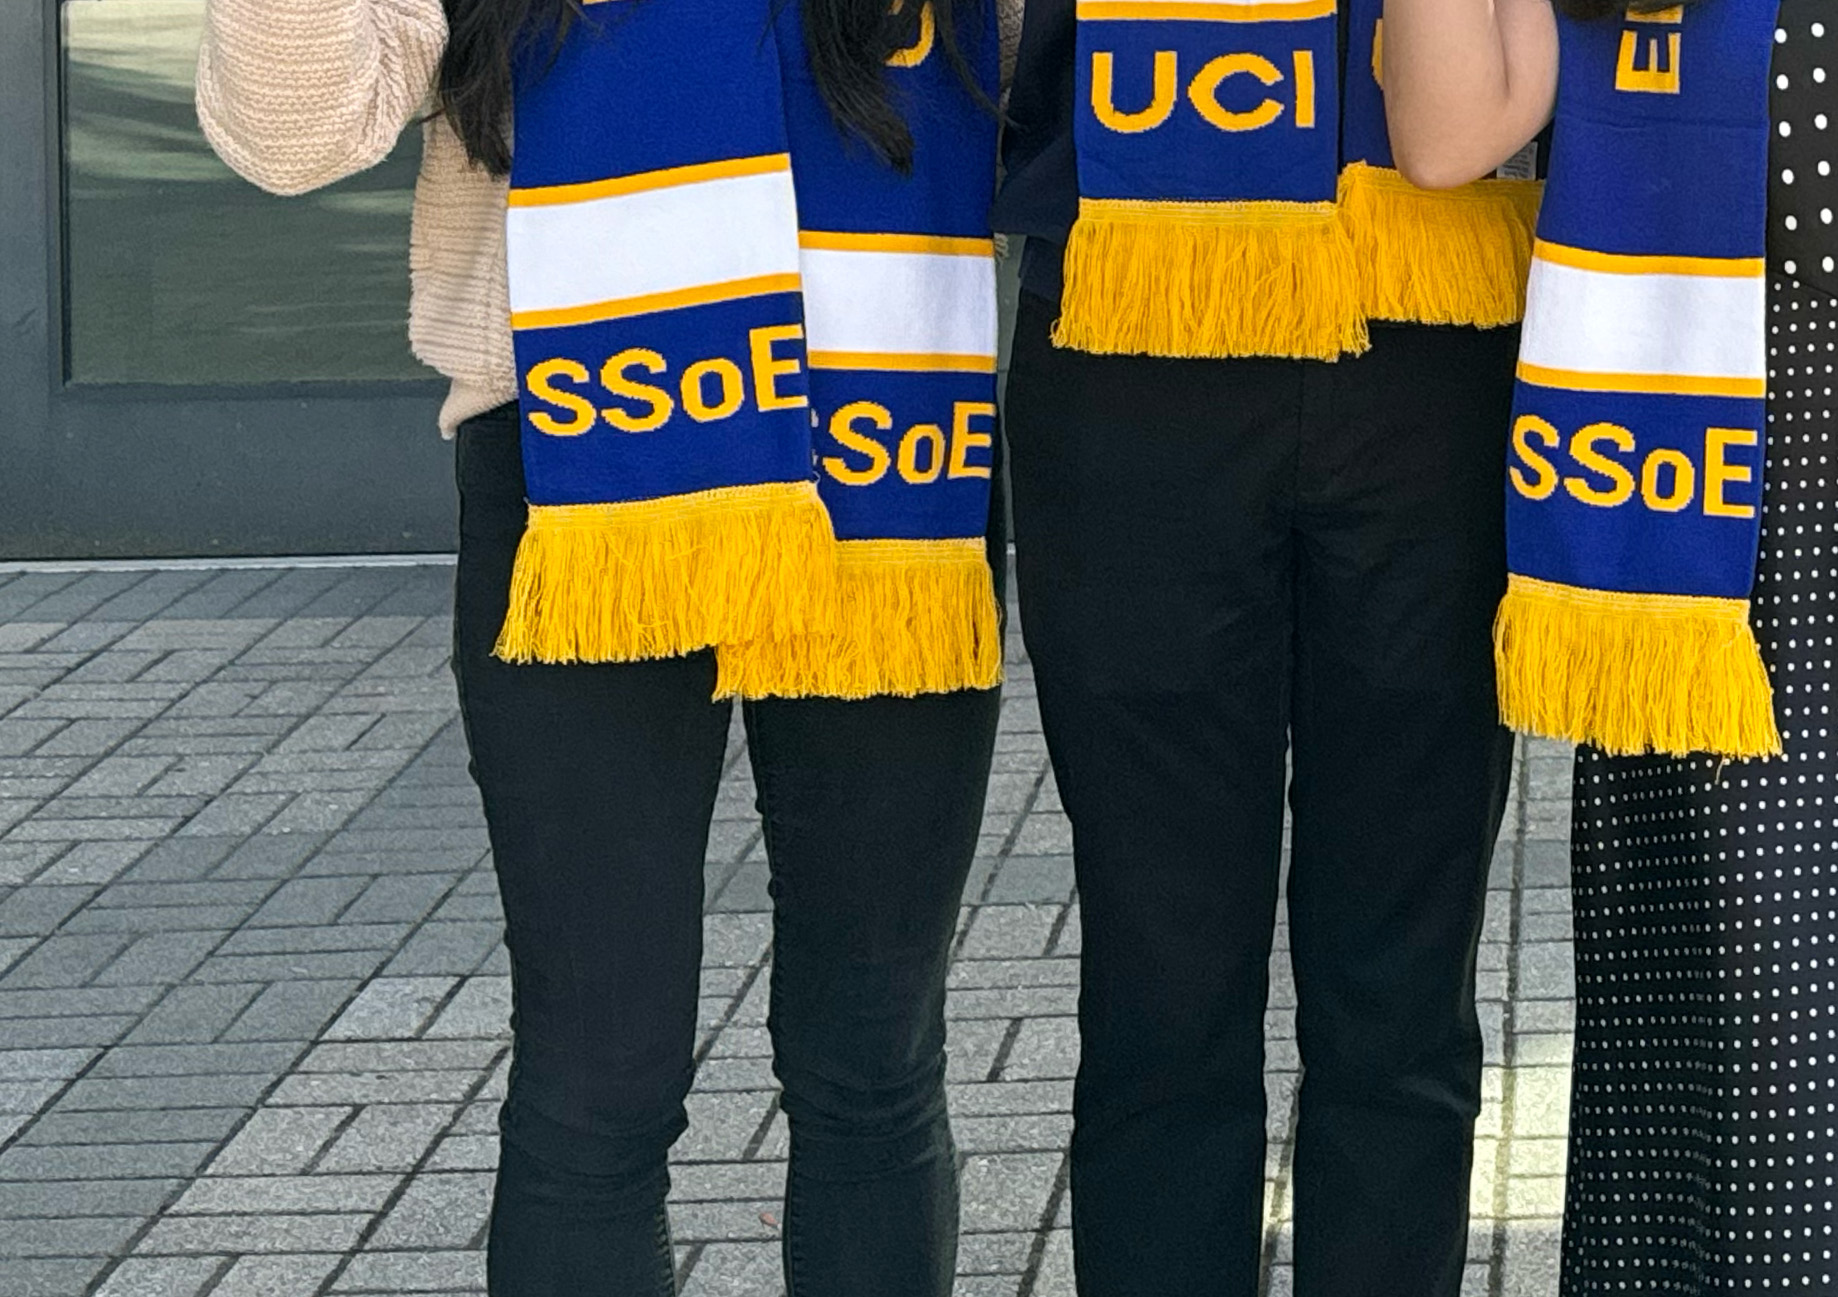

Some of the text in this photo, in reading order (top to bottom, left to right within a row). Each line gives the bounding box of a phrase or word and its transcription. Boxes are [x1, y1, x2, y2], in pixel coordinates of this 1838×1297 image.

[1091, 49, 1316, 134] UCI
[526, 323, 810, 437] SSoE
[811, 400, 997, 486] SoE
[1508, 412, 1757, 519] SSoE
